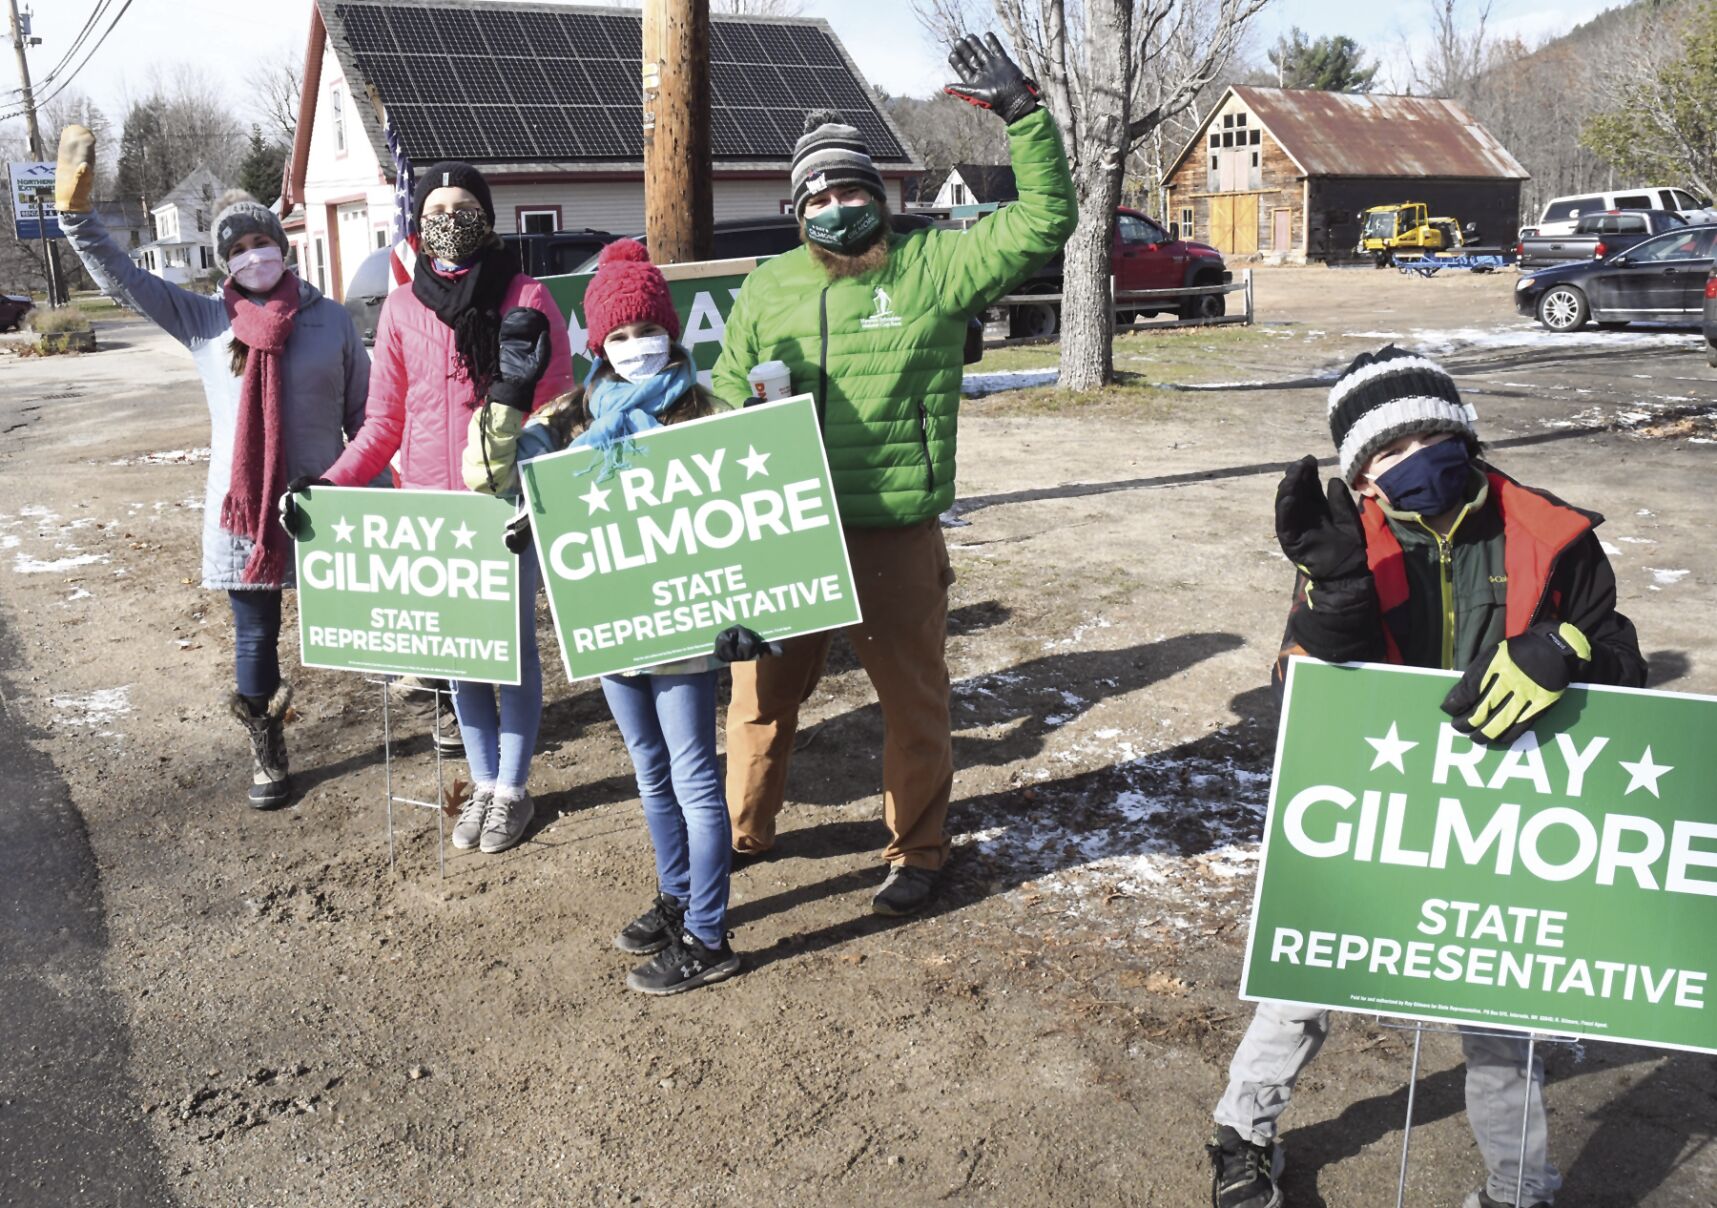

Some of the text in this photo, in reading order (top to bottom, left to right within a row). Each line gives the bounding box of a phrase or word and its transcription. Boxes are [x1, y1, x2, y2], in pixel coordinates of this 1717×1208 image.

[620, 448, 726, 511] RAY
[363, 514, 444, 551] RAY
[550, 478, 829, 580] GILMORE
[303, 550, 510, 601] GILMORE
[652, 564, 746, 606] STATE
[371, 608, 440, 632] STATE
[572, 574, 842, 653] REPRESENTATIVE
[309, 625, 509, 662] REPRESENTATIVE
[1431, 721, 1610, 797] RAY
[1282, 784, 1717, 898] GILMORE
[1417, 898, 1568, 948] STATE
[1270, 927, 1708, 1009] REPRESENTATIVE
